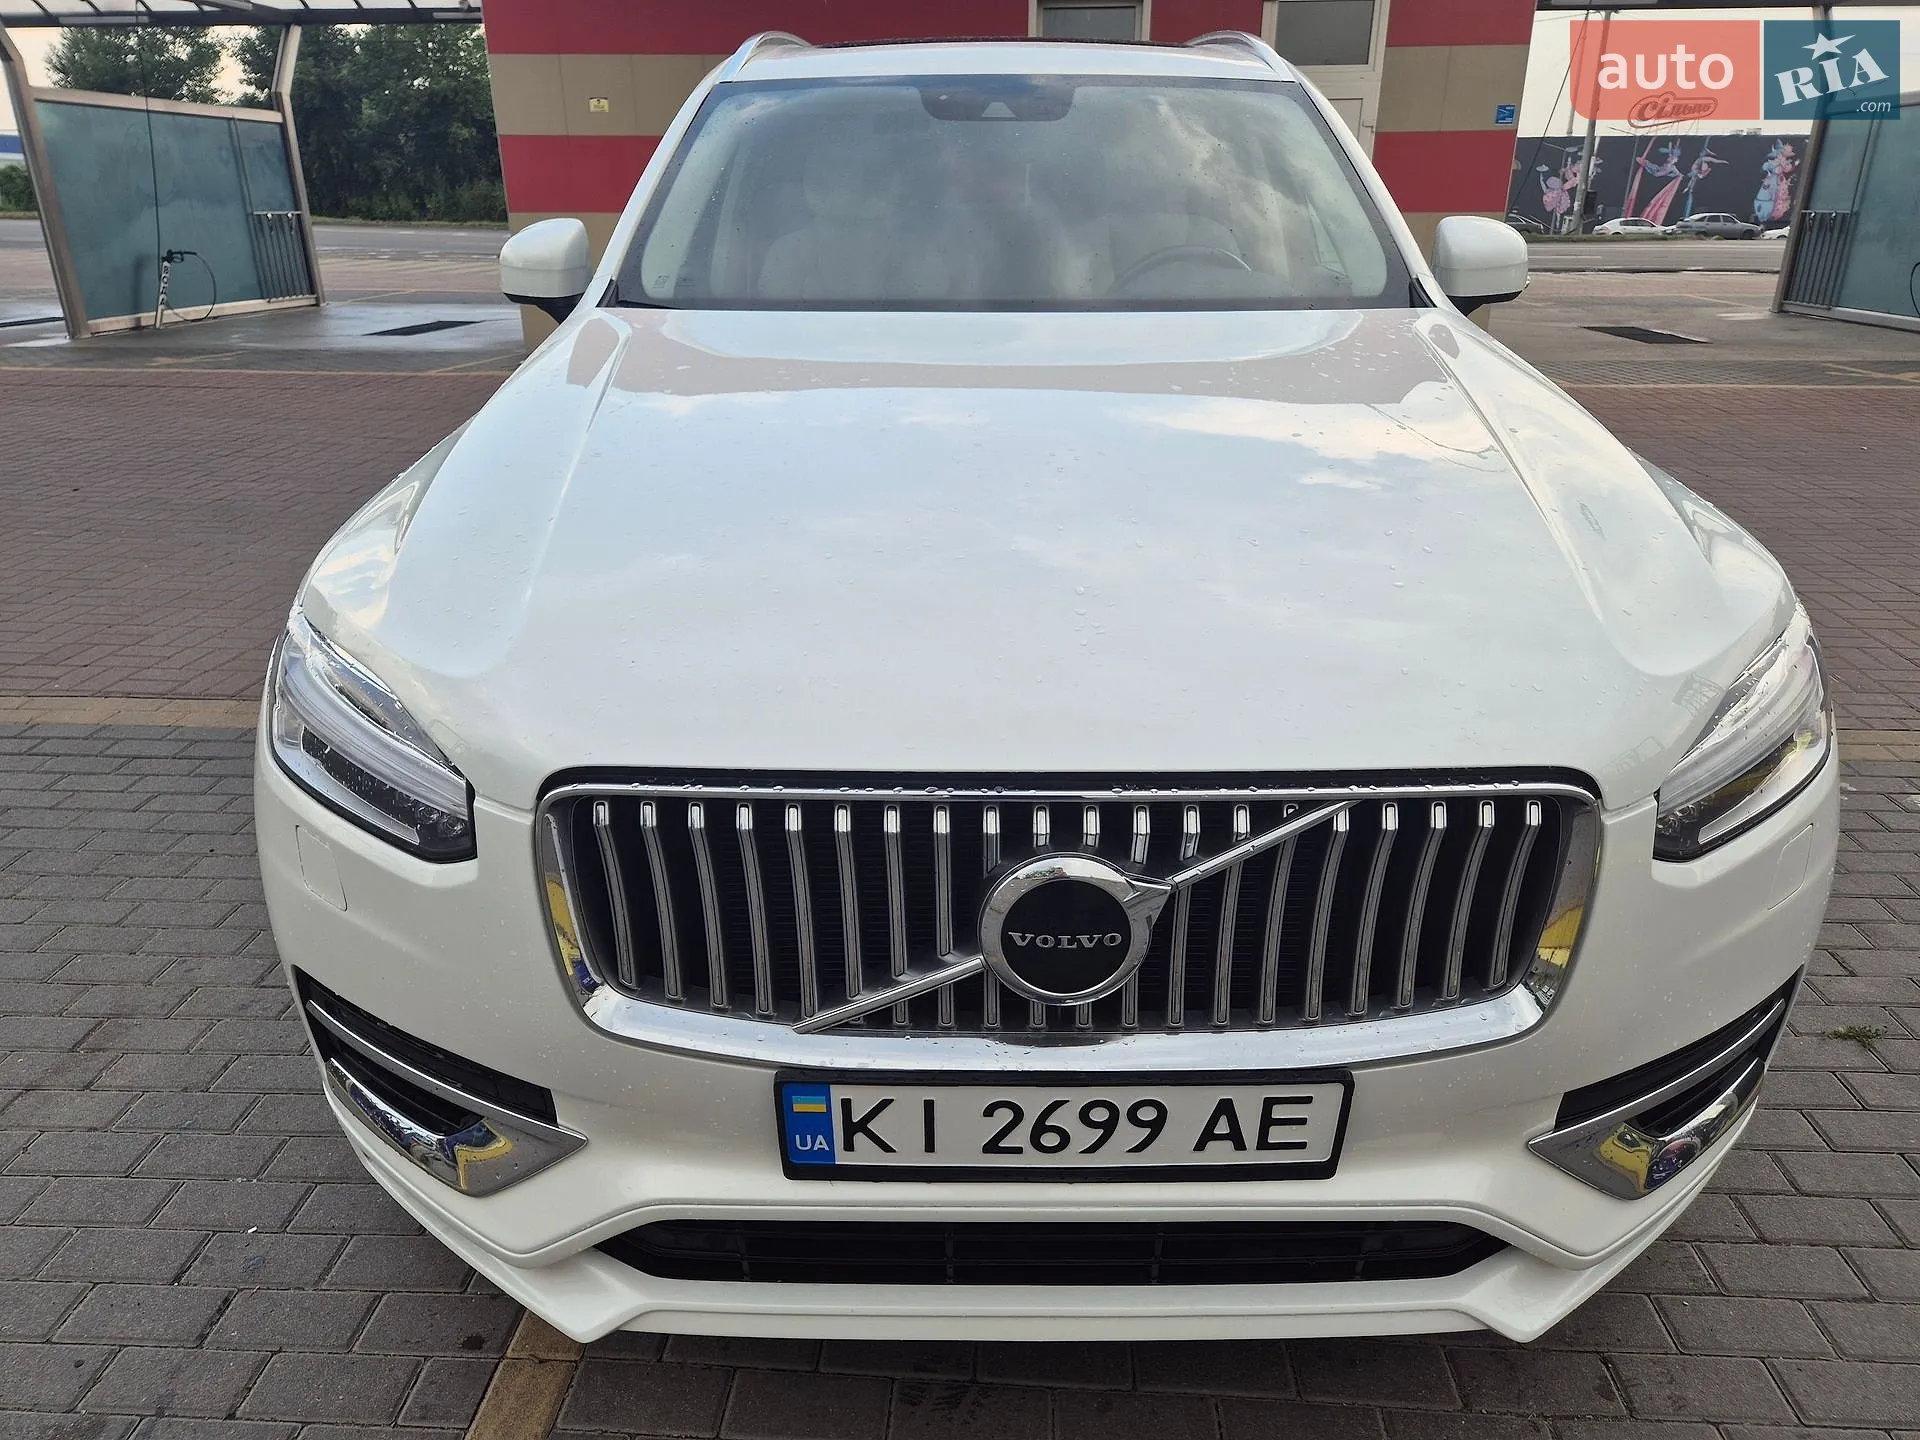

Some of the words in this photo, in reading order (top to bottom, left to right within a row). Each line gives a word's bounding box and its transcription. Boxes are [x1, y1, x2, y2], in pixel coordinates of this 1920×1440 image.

[1008, 931, 1122, 948] VOLVO
[981, 1099, 1169, 1155] 2699
[1192, 1095, 1315, 1152] AE
[795, 1134, 830, 1151] UA
